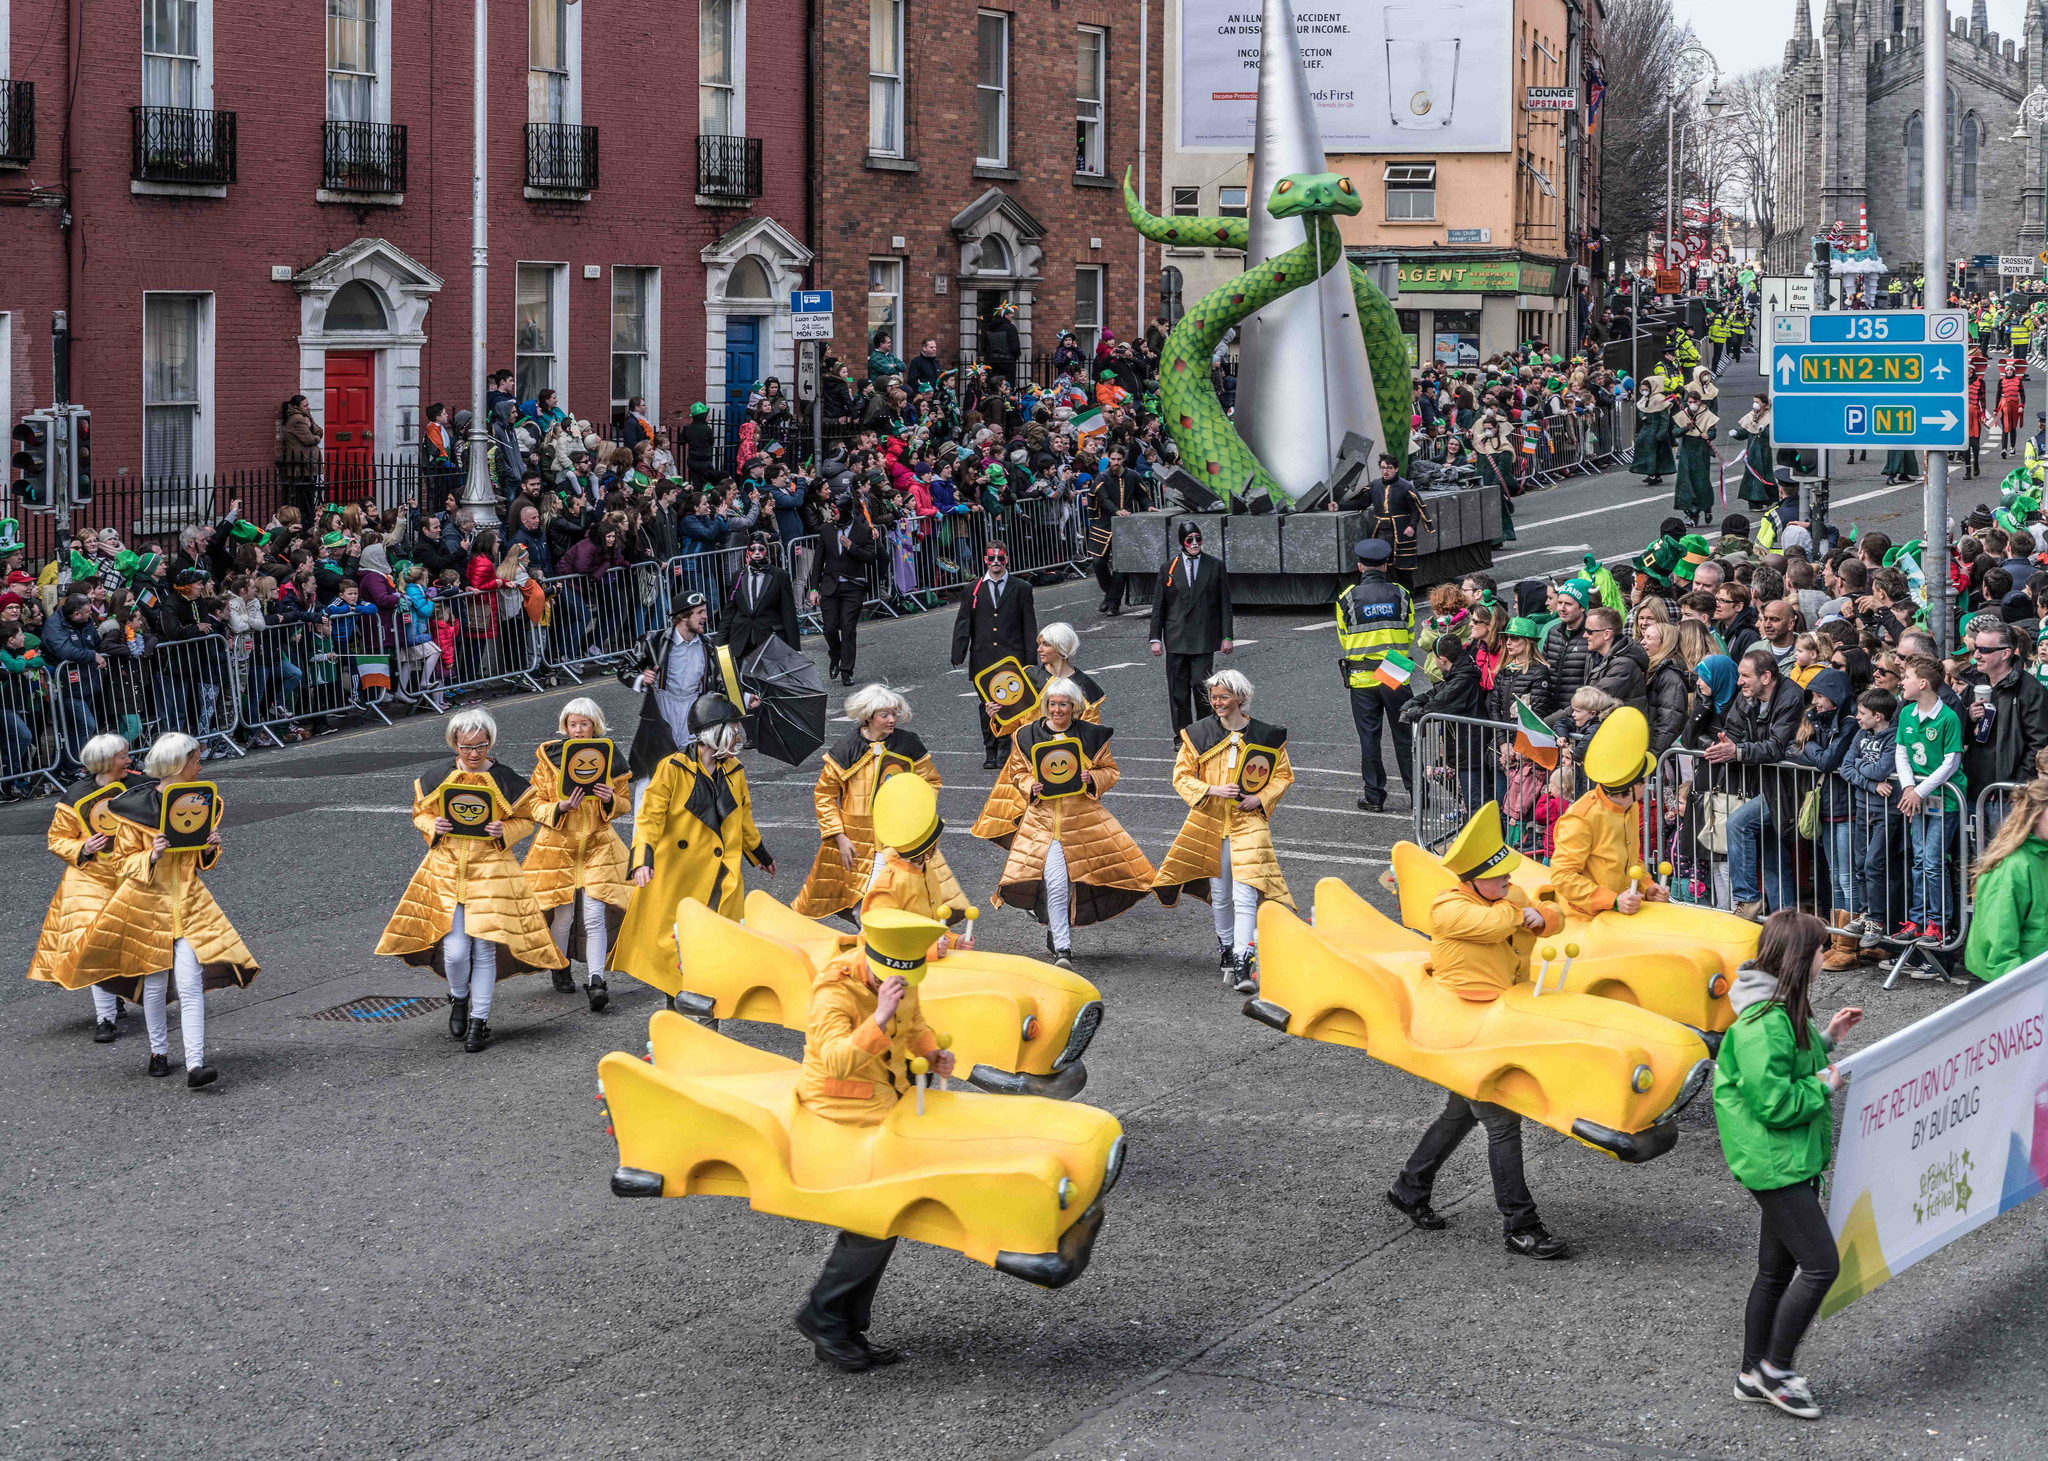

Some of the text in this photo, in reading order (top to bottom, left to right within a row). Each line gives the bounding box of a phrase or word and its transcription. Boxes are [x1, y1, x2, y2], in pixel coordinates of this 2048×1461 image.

[1296, 14, 1342, 22] ACCIDENT
[1218, 25, 1350, 34] CAN DISS UR INCOME.
[1300, 49, 1332, 57] ECTION
[1304, 60, 1324, 68] LIEF.
[1330, 90, 1354, 100] First
[1528, 89, 1574, 97] LOUNGE
[1529, 100, 1573, 108] UPSTAIRS
[1398, 268, 1468, 282] AGENT
[1845, 318, 1889, 339] J35
[1848, 409, 1863, 430] P
[1364, 606, 1394, 617] GARDA
[1912, 742, 1927, 766] 3
[1487, 848, 1508, 866] TAXI
[885, 958, 914, 969] TAXI
[1889, 1064, 1941, 1123] RETURN
[1943, 1053, 1961, 1091] OF
[1964, 1038, 1986, 1079] THE
[1912, 1115, 1929, 1150] BY
[1950, 1086, 1980, 1128] BOLG
